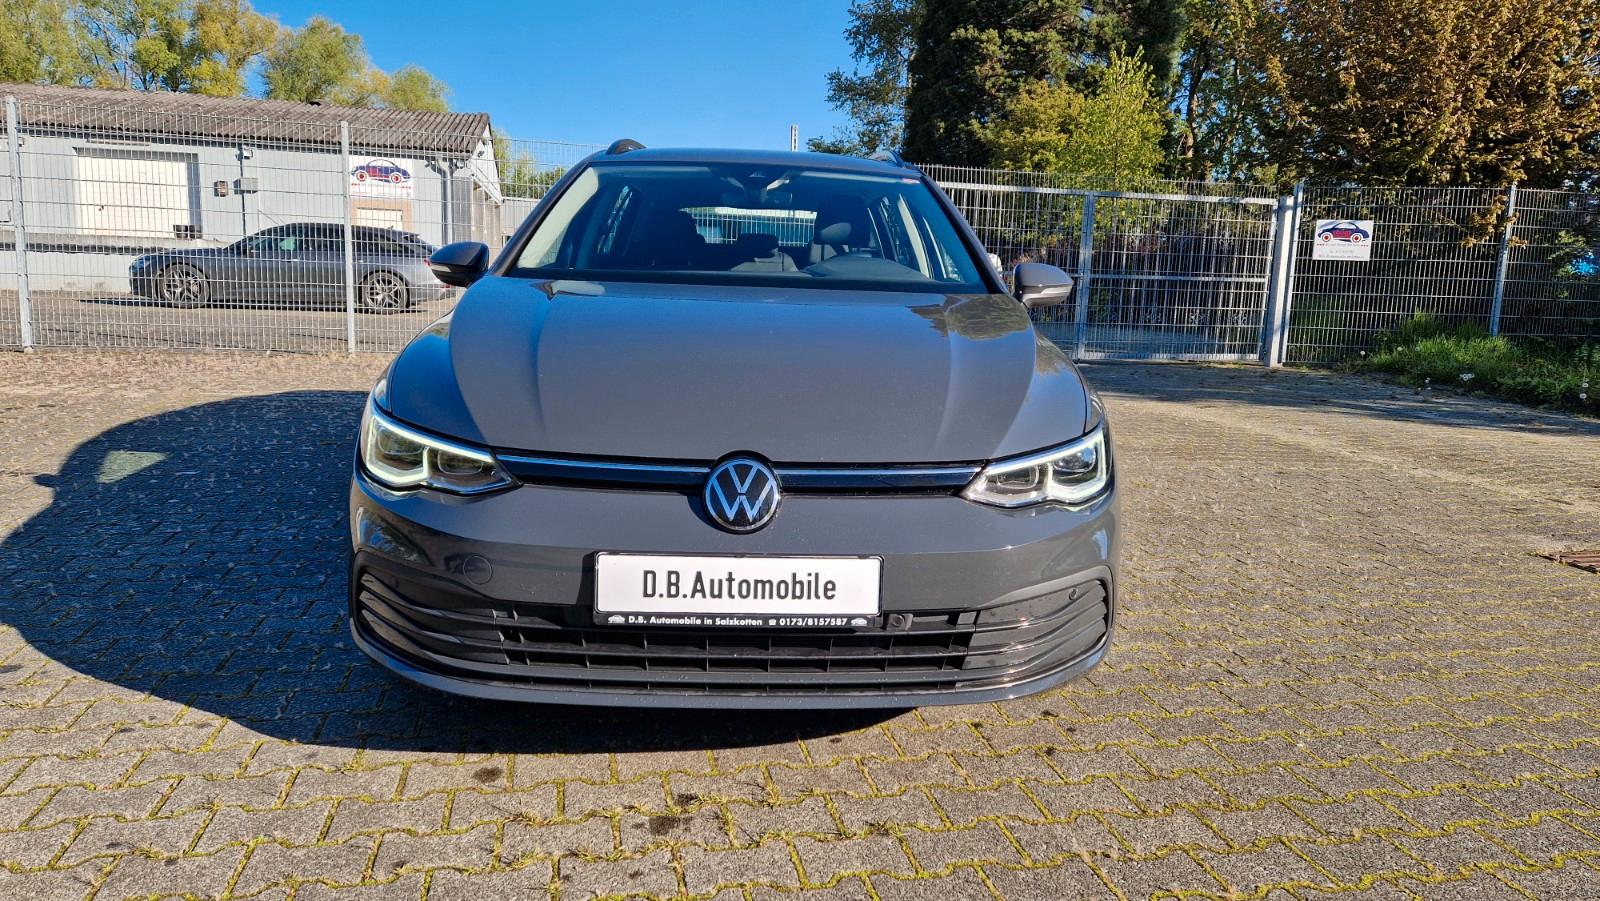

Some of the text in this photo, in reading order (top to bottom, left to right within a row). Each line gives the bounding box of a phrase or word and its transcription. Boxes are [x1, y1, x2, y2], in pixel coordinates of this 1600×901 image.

[709, 463, 774, 523] VW
[628, 615, 848, 627] D.B. Automobile in Salzkotten 0173/8157587
